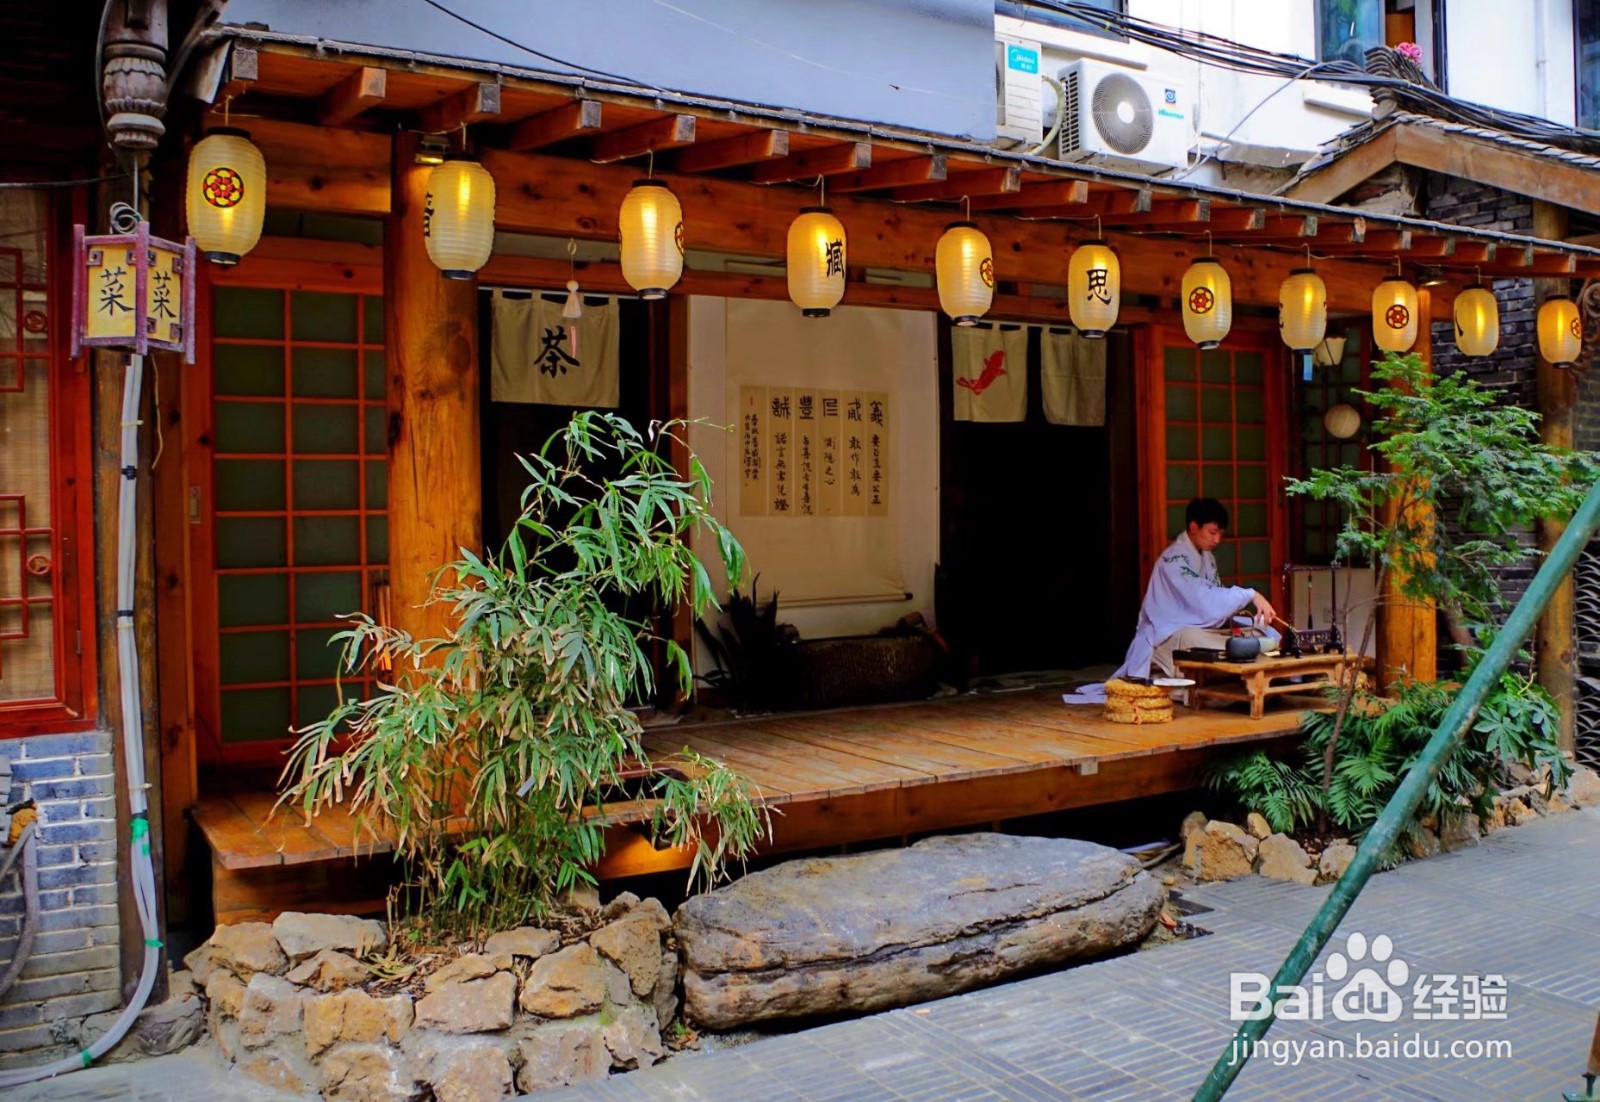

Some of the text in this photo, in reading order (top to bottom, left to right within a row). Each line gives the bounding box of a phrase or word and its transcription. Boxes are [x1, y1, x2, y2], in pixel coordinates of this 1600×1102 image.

[826, 238, 845, 279] 藏
[97, 266, 135, 316] 菜
[152, 271, 177, 321] 菜
[1086, 268, 1112, 306] 思
[534, 325, 580, 379] 茶
